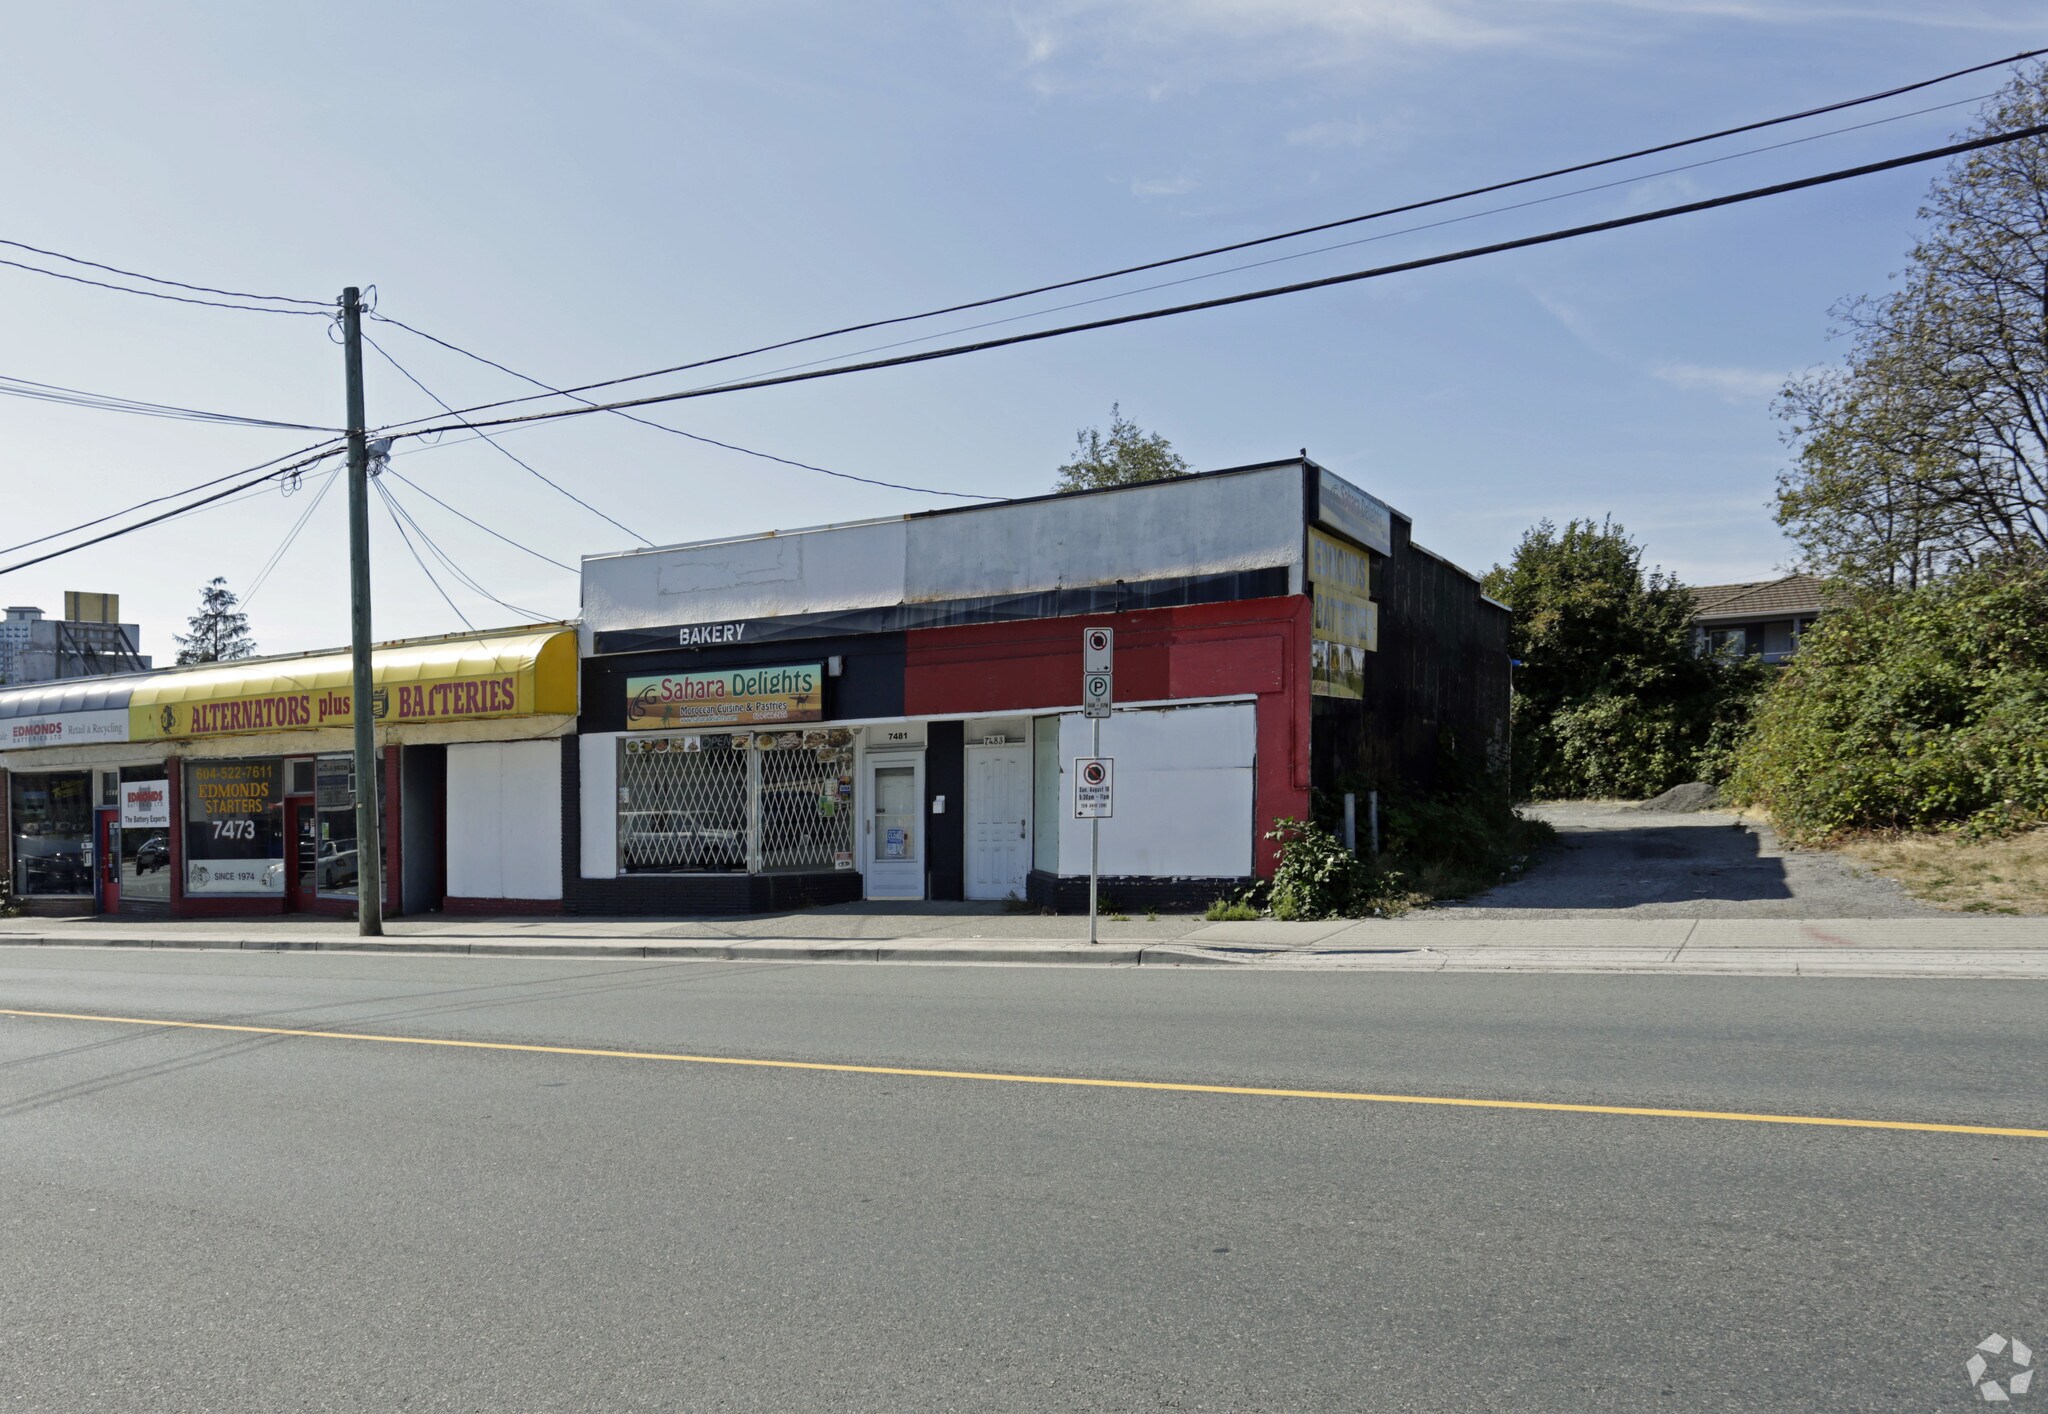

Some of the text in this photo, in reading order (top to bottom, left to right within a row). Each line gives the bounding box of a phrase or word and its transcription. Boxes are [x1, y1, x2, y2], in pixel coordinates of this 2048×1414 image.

[1314, 538, 1366, 590] EDMONDS
[680, 623, 745, 646] BAKERY
[660, 670, 813, 702] Sahara Delights
[1094, 681, 1103, 692] P
[398, 677, 514, 718] BATTERIES
[190, 691, 350, 733] ALTERNATORS plus
[680, 701, 787, 716] Moroccan Cuisine & Pastries
[12, 722, 62, 738] EDMONDS
[68, 724, 86, 736] Retail
[92, 722, 122, 736] Recycling
[888, 732, 908, 740] 7481
[12, 734, 47, 744] BATTERIES
[701, 734, 732, 750] OPEN
[984, 736, 1004, 746] 7483
[196, 764, 272, 780] 604-522-7611
[128, 790, 162, 803] EDMONDS
[198, 782, 269, 799] EDMONDS
[205, 798, 263, 814] STARTERS
[134, 816, 149, 824] Battery
[150, 815, 167, 824] Experts
[212, 820, 256, 840] 7473
[214, 872, 255, 881] SINCE 1974
